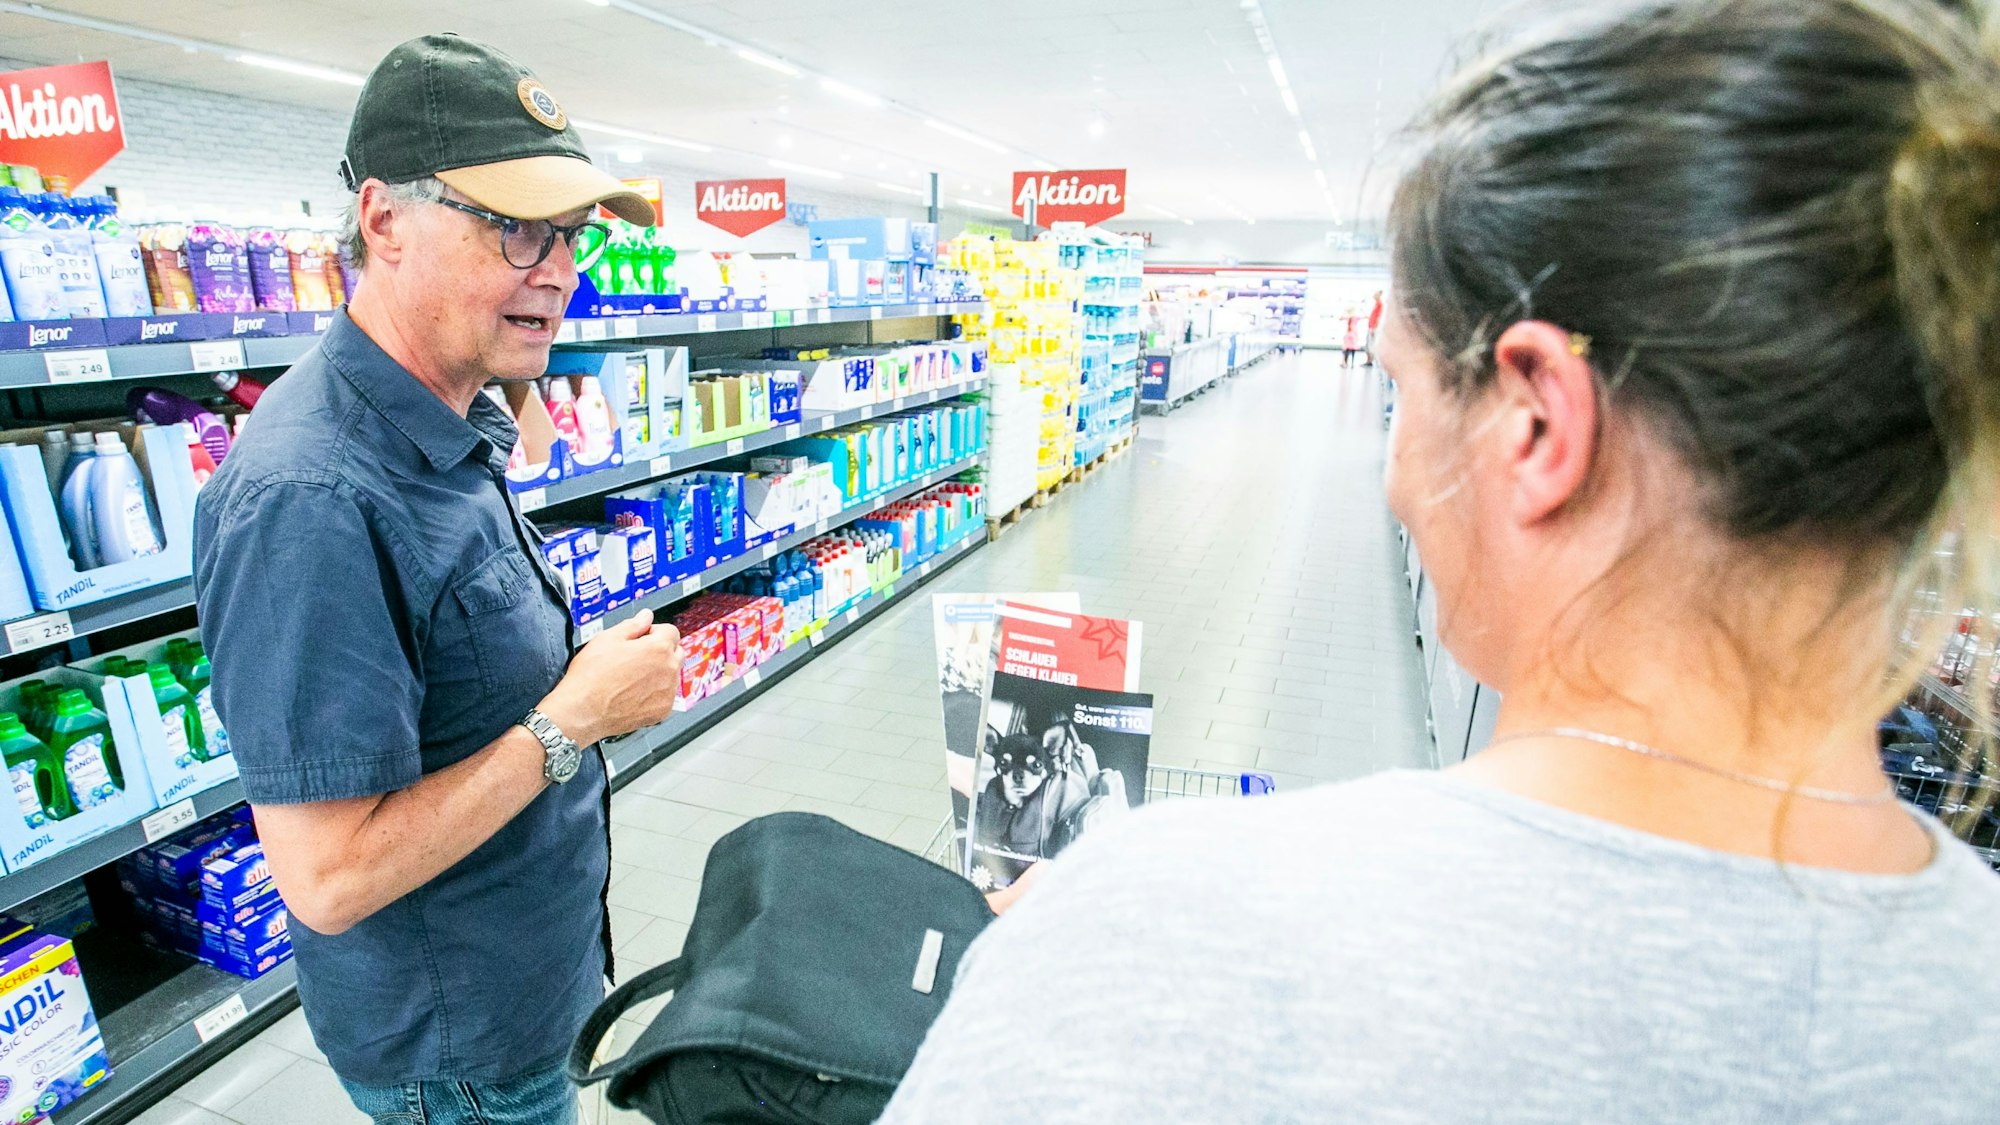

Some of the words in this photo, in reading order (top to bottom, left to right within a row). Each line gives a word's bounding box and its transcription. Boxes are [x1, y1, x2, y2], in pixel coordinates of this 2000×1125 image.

[0, 82, 115, 139] Aktion
[698, 185, 783, 212] Aktion
[1015, 175, 1121, 206] Aktion
[206, 249, 233, 267] Lenor
[19, 262, 54, 279] Lenor
[111, 264, 141, 279] Lenor
[141, 319, 179, 340] Lenor
[232, 315, 267, 335] Lenor
[29, 324, 73, 347] Lenor
[81, 363, 103, 375] 2.49
[220, 355, 239, 365] 2.49
[579, 566, 599, 583] alio
[55, 577, 97, 605] TANDiL
[43, 623, 70, 638] 2.25
[1005, 646, 1058, 669] SCHLAUER
[1038, 668, 1078, 687] KLAUER
[1073, 710, 1118, 728] Sonst
[69, 754, 100, 774] TANDiL
[163, 774, 198, 801] TANDiL
[172, 807, 193, 824] 3.55
[12, 833, 55, 866] TANDiL
[248, 861, 268, 884] ali
[24, 1002, 63, 1037] COLOR
